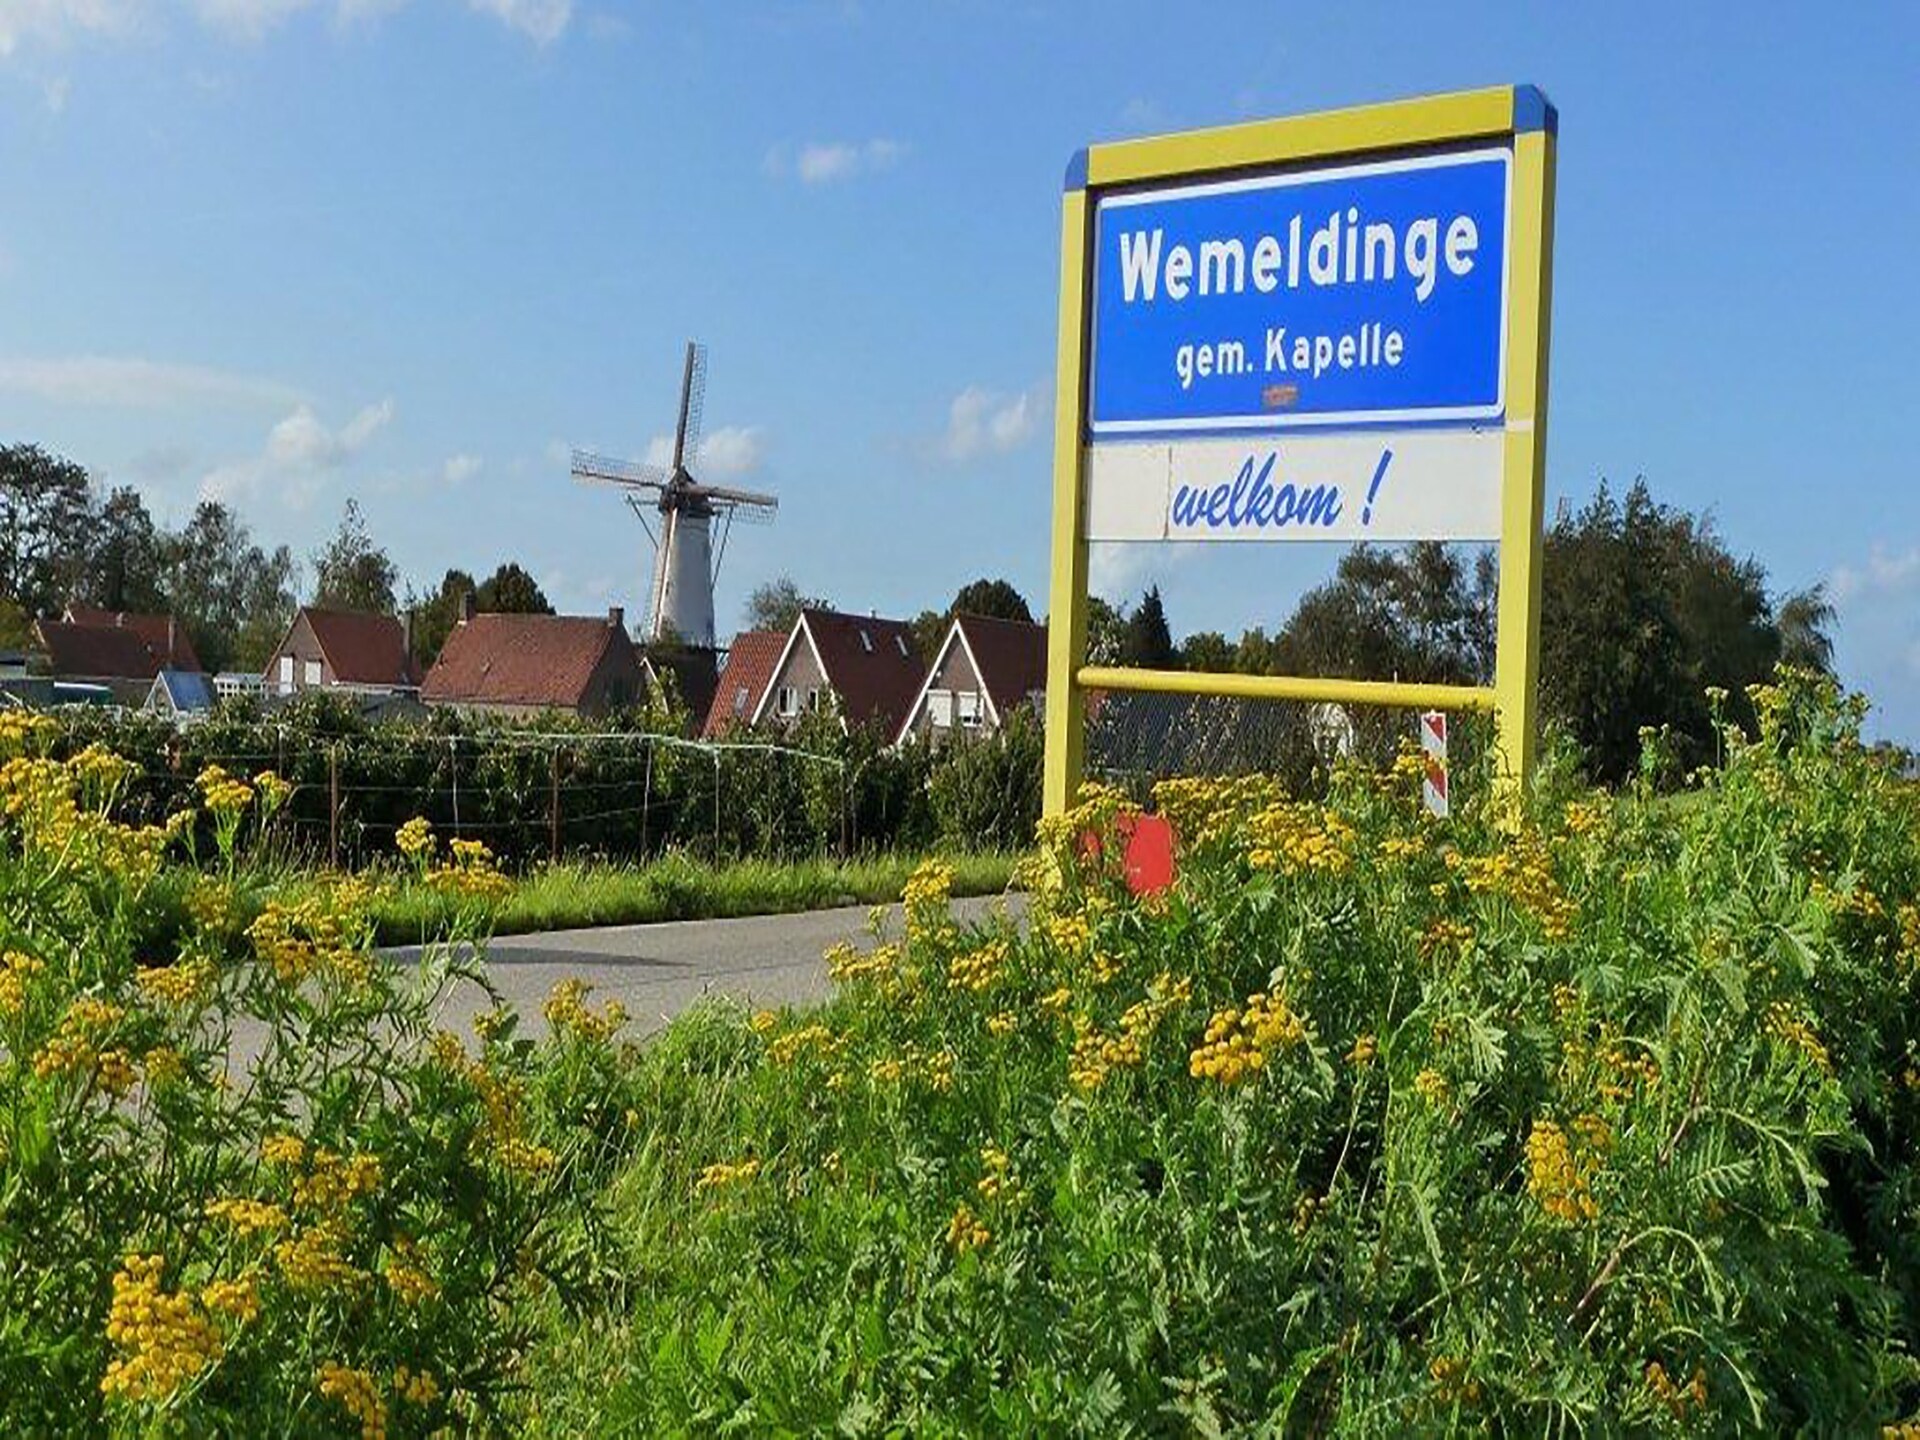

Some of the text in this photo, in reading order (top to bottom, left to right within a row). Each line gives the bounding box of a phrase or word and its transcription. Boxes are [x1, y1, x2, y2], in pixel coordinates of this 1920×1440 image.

[1118, 206, 1479, 303] Wemeldinge
[1175, 322, 1404, 390] gem. Kapelle
[1172, 452, 1343, 528] welkom
